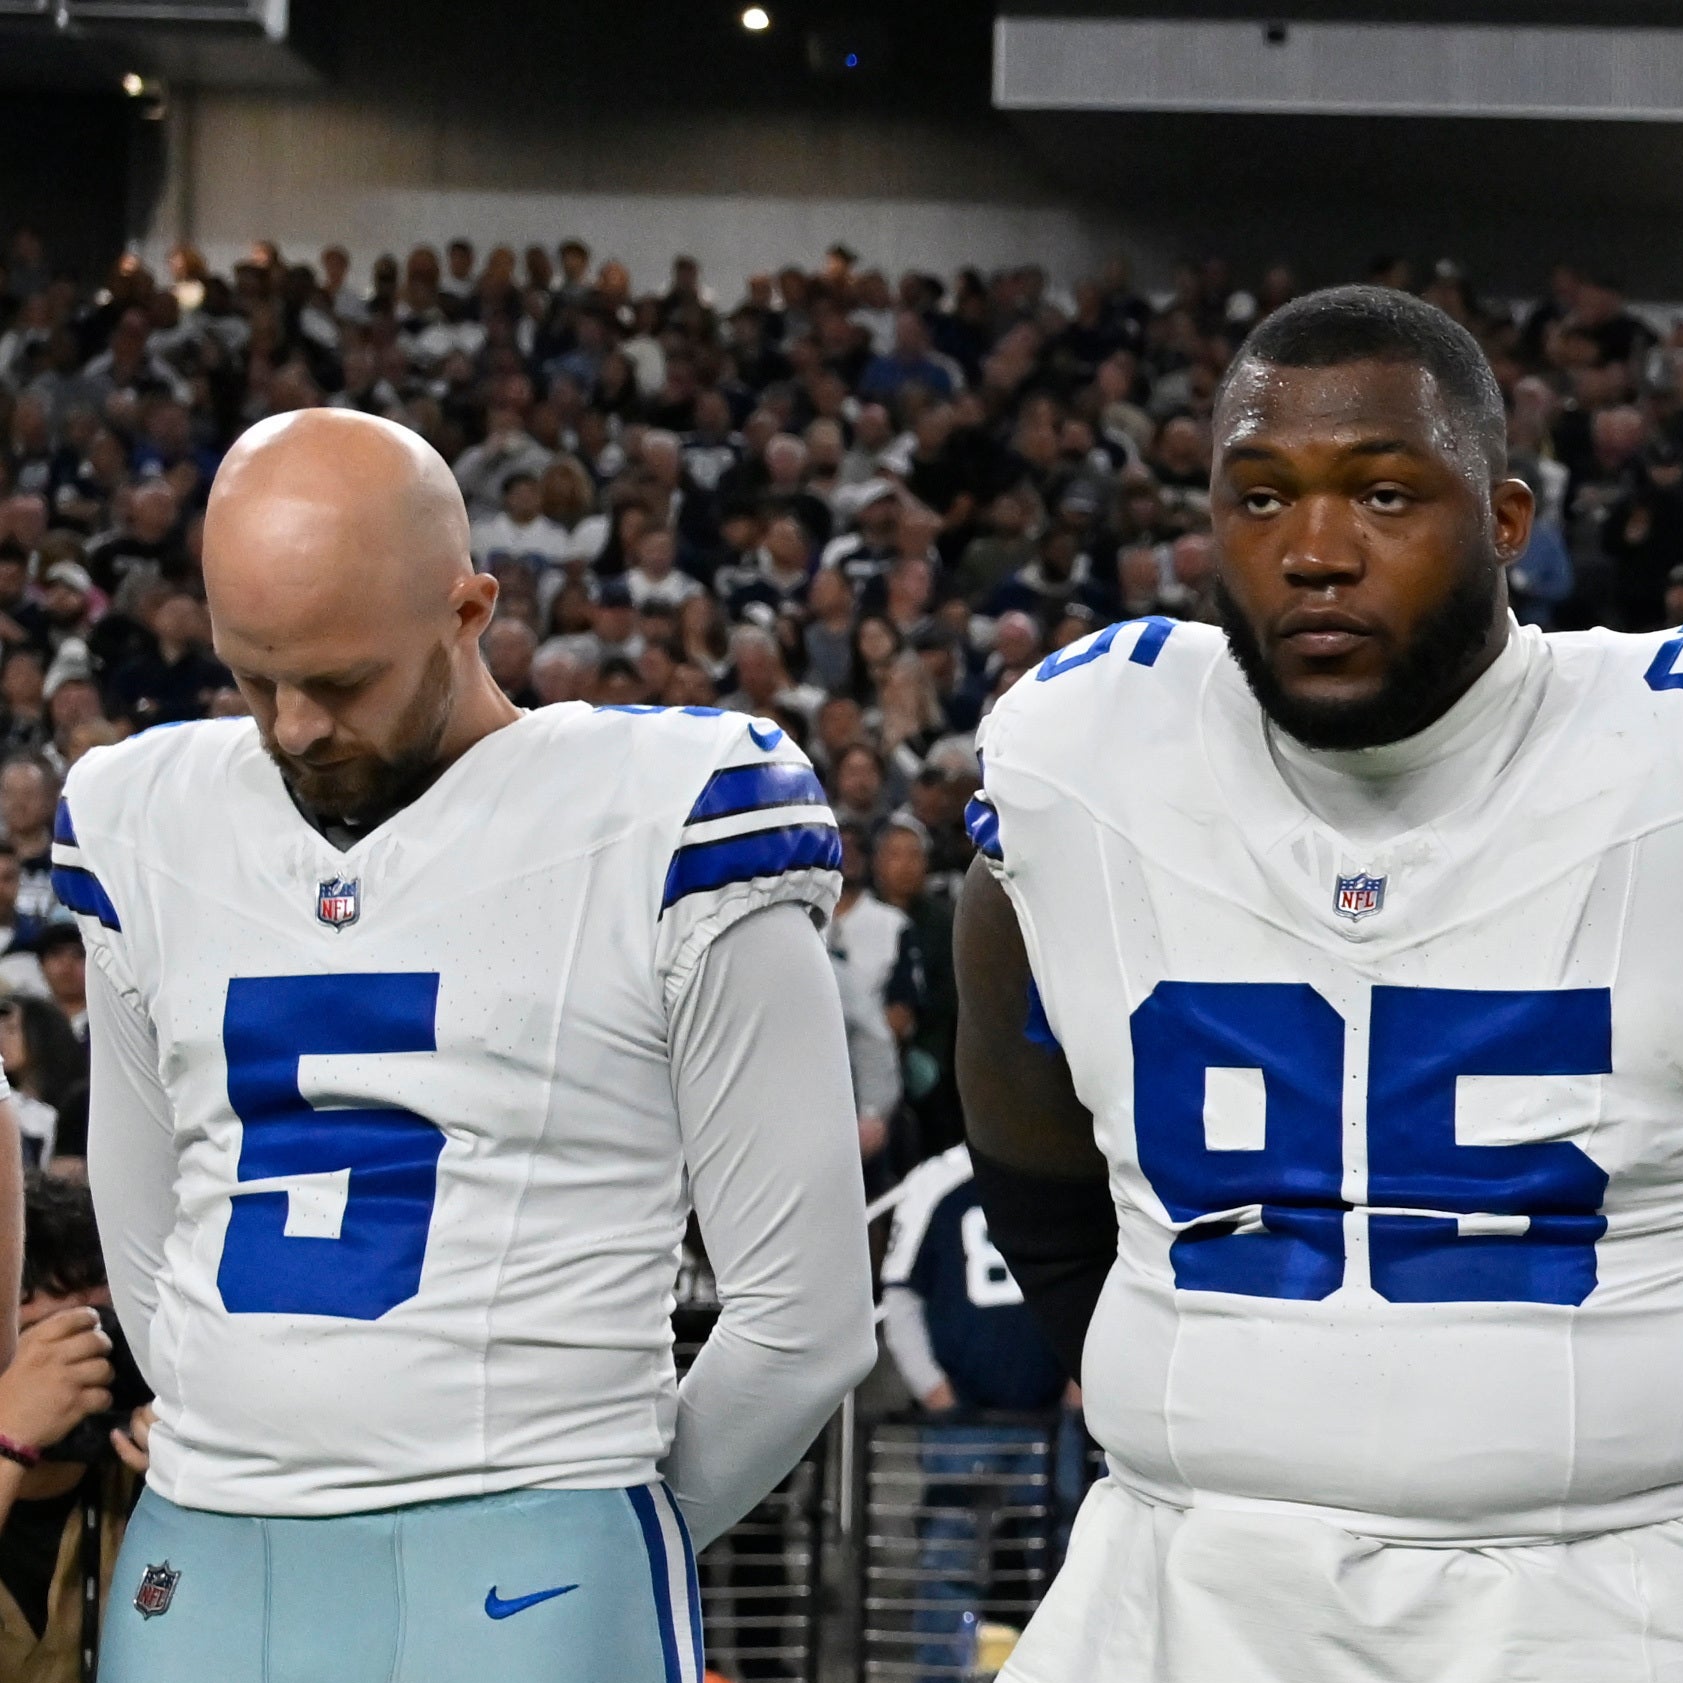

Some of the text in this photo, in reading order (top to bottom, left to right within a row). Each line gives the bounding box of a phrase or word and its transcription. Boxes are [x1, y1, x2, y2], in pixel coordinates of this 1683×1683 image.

[321, 899, 351, 920] NFL
[1341, 890, 1375, 910] NFL
[217, 972, 447, 1321] 5
[1130, 980, 1613, 1306] 95
